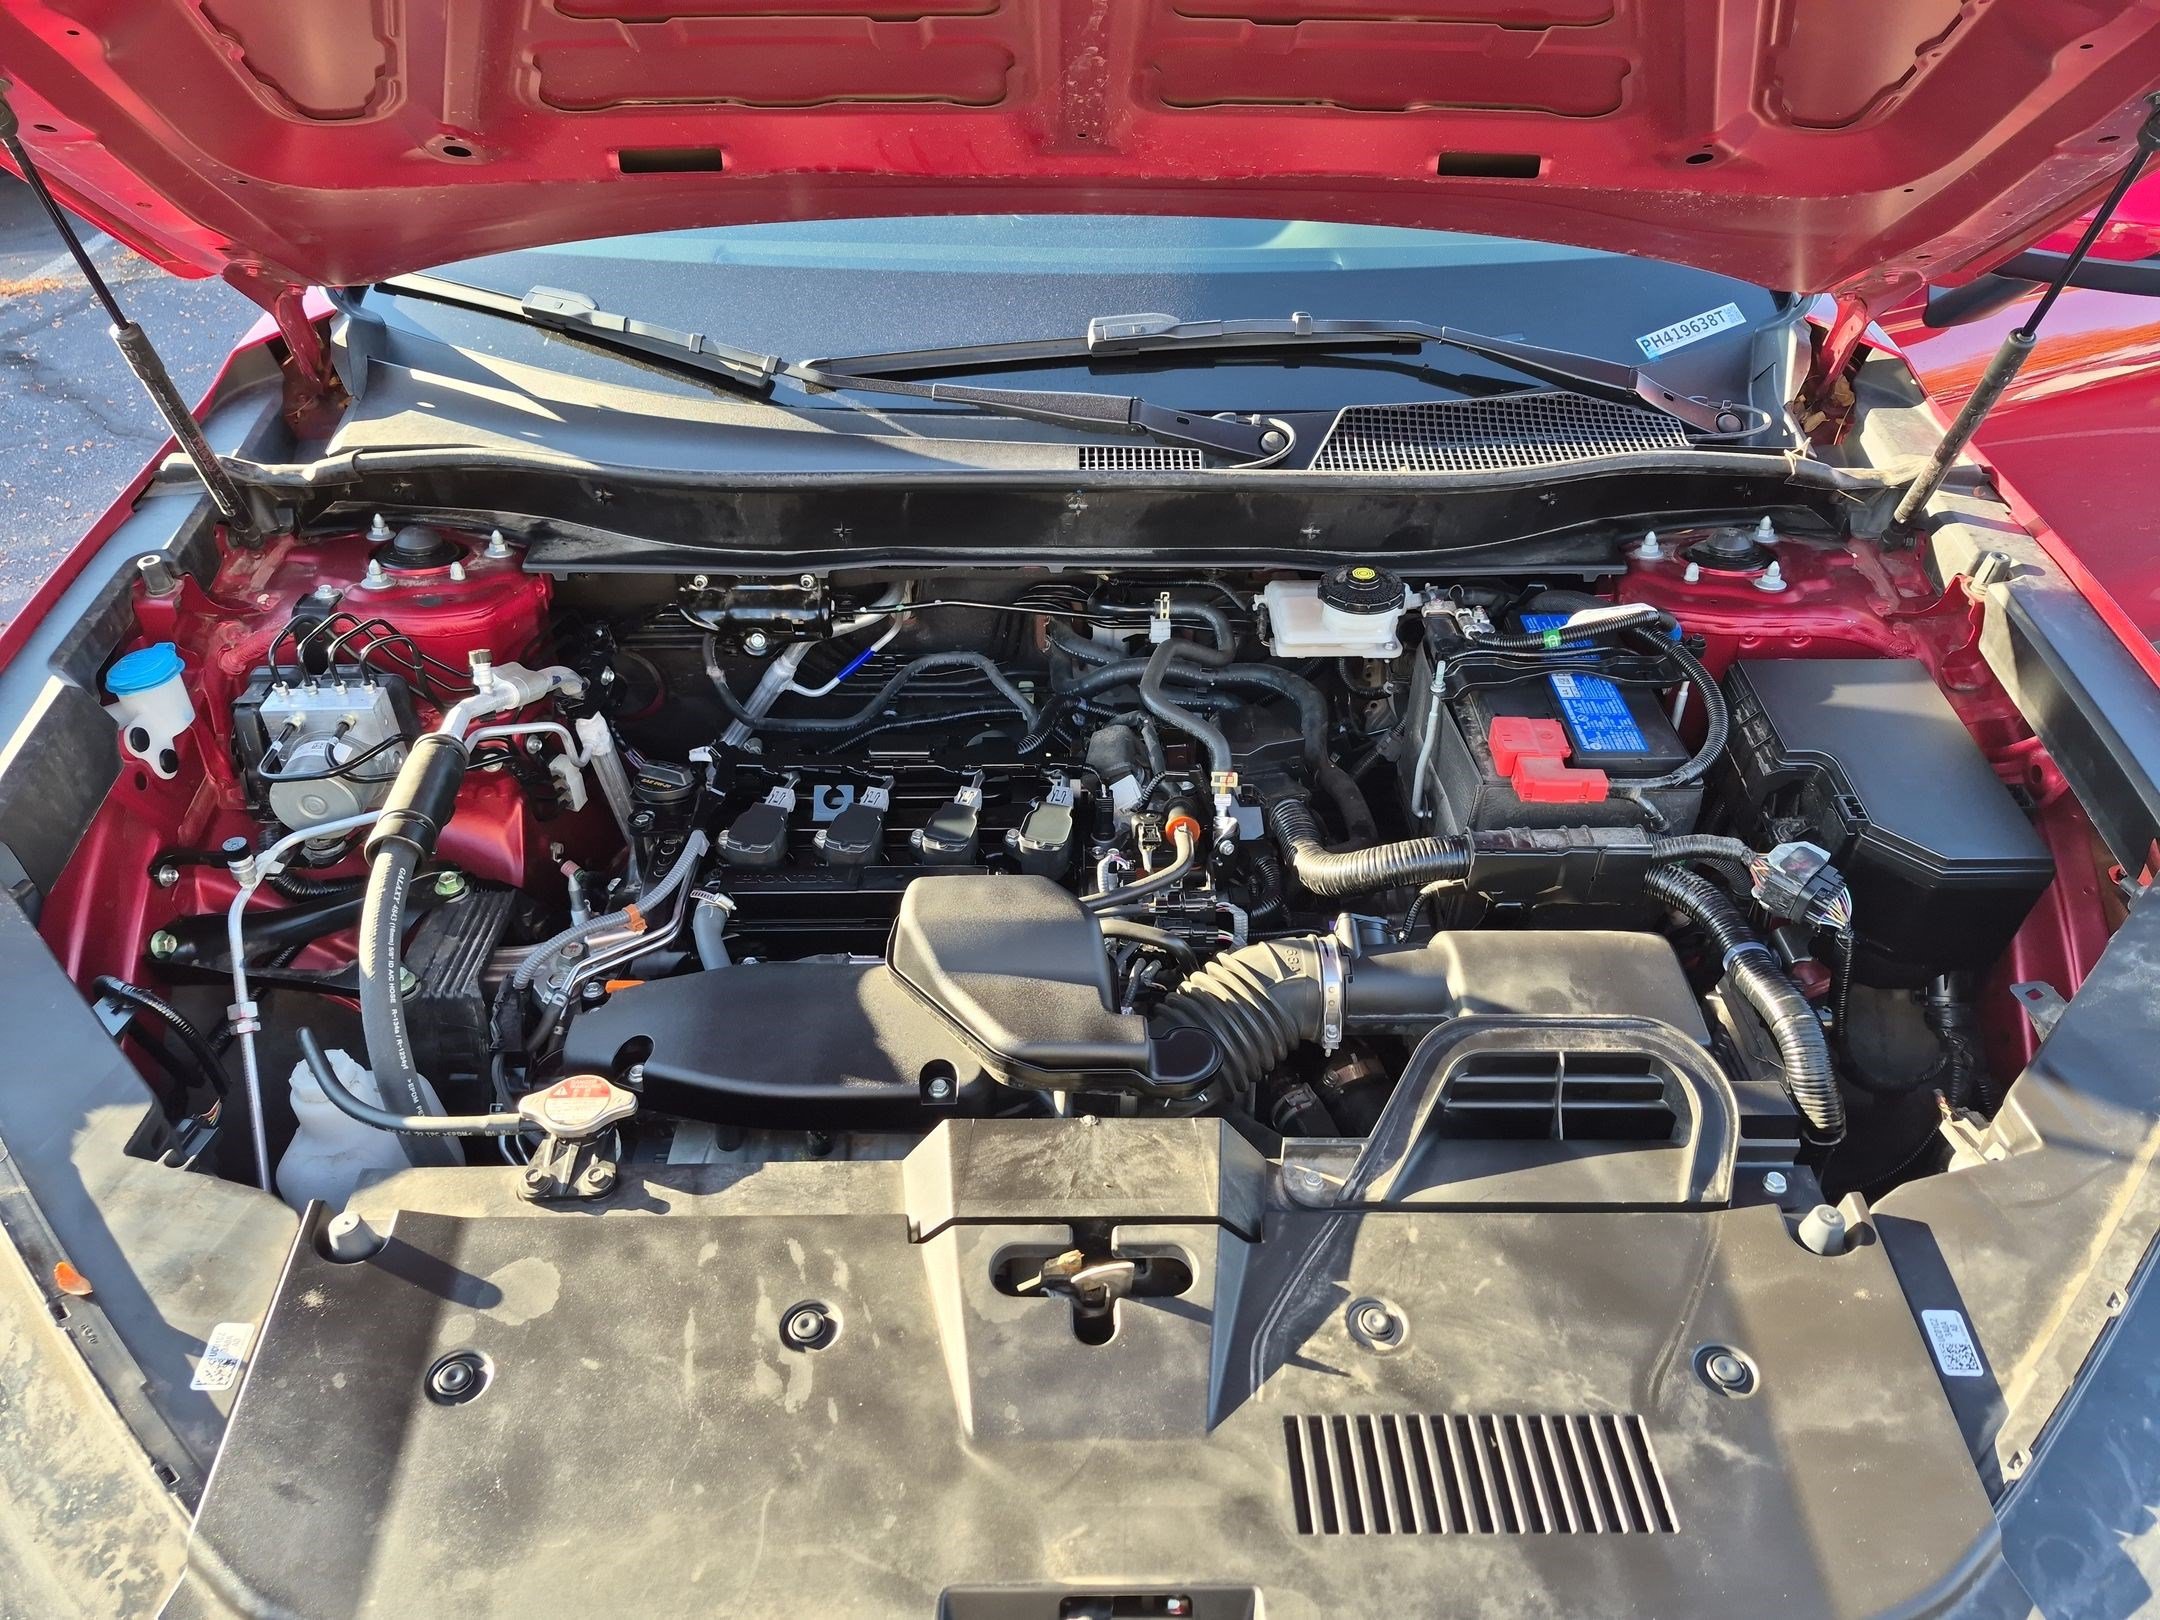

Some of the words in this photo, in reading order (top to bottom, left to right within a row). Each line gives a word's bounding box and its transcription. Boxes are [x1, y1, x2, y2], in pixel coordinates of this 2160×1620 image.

[1640, 310, 1726, 352] PH419638T
[393, 867, 406, 904] GALAXY
[390, 904, 399, 921] 4843
[388, 960, 395, 968] ID
[389, 983, 397, 1003] HOSE
[391, 1008, 399, 1034] R-134a
[396, 1038, 409, 1070] R-1234yf
